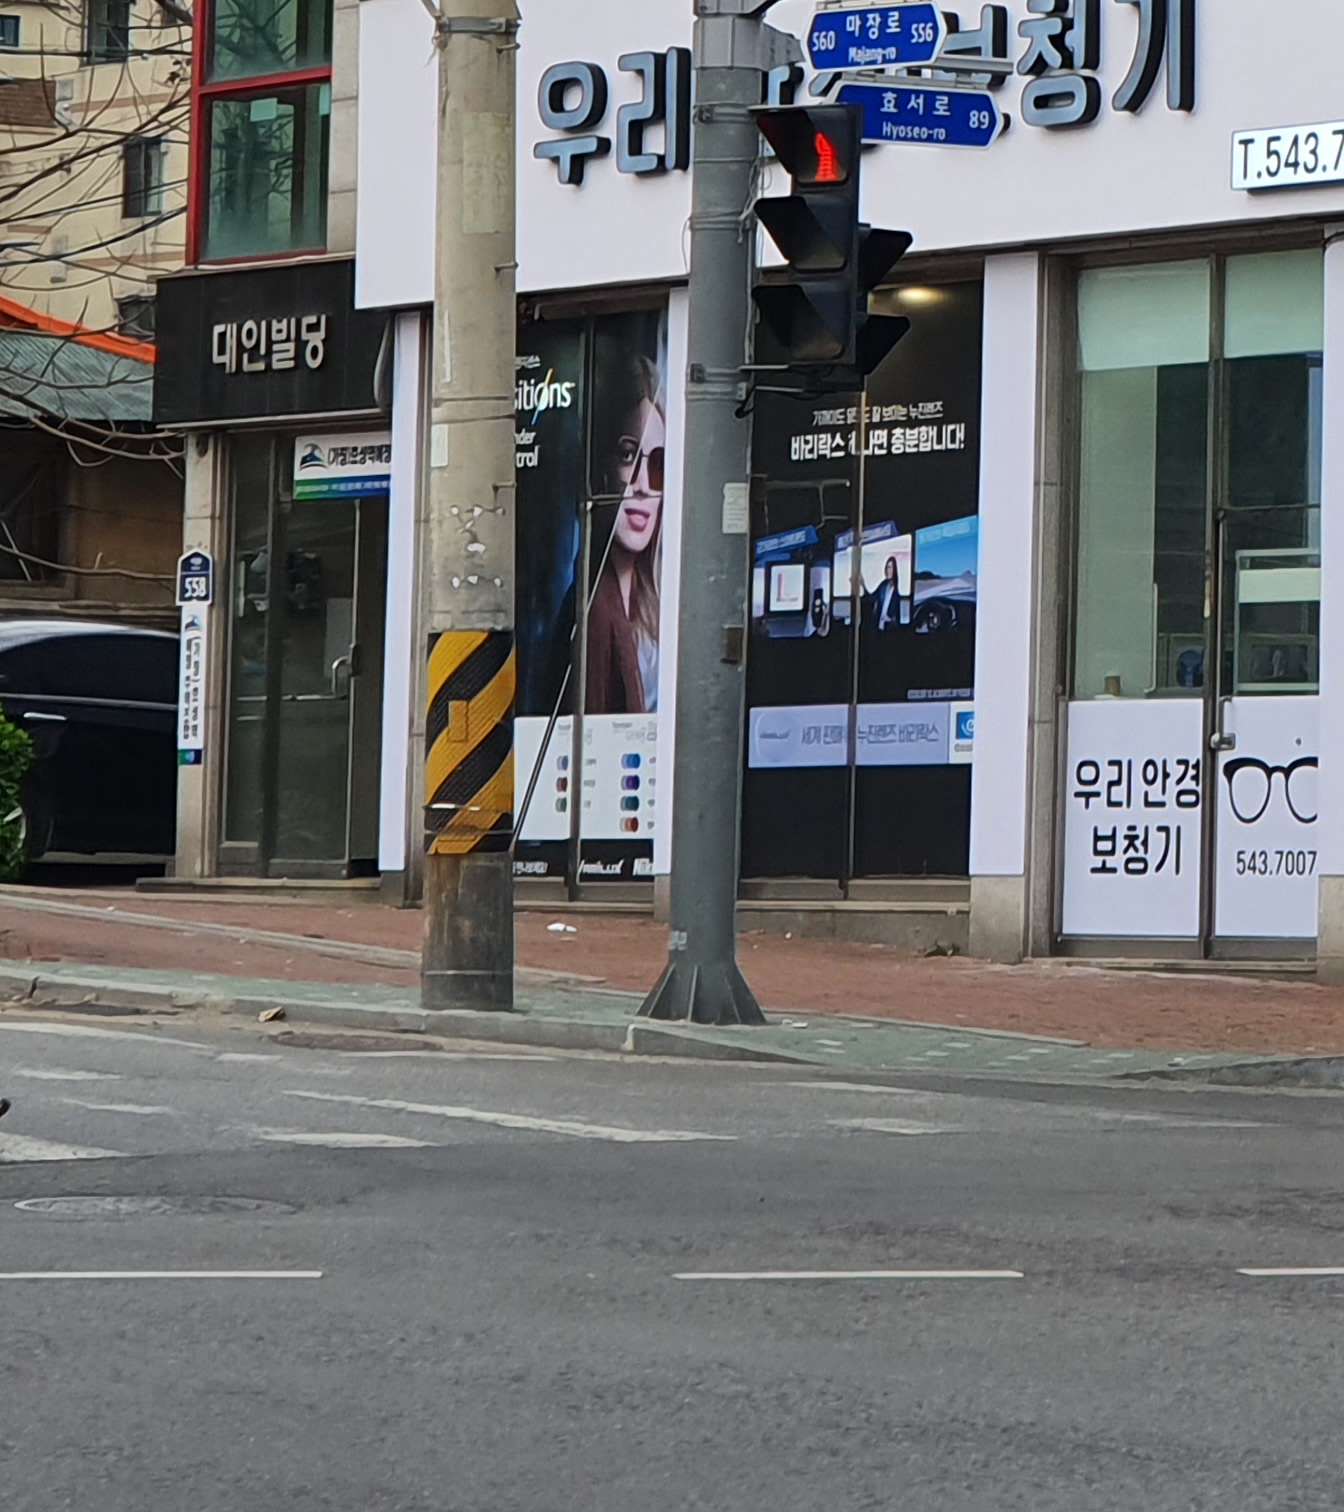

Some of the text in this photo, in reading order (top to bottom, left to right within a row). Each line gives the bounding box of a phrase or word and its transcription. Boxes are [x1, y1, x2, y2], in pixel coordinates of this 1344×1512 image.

[846, 9, 902, 39] 마장로
[909, 22, 934, 44] 556
[811, 30, 836, 51] 560
[847, 45, 897, 64] Majang-ro
[879, 90, 951, 116] 효서로
[881, 121, 947, 141] Hyoseo-ro
[968, 109, 990, 129] 89
[212, 314, 327, 374] 대인빌딩
[790, 431, 846, 462] 바리락스
[184, 576, 207, 598] 558
[1090, 824, 1182, 876] 보청기
[1236, 850, 1318, 876] 543.7007
